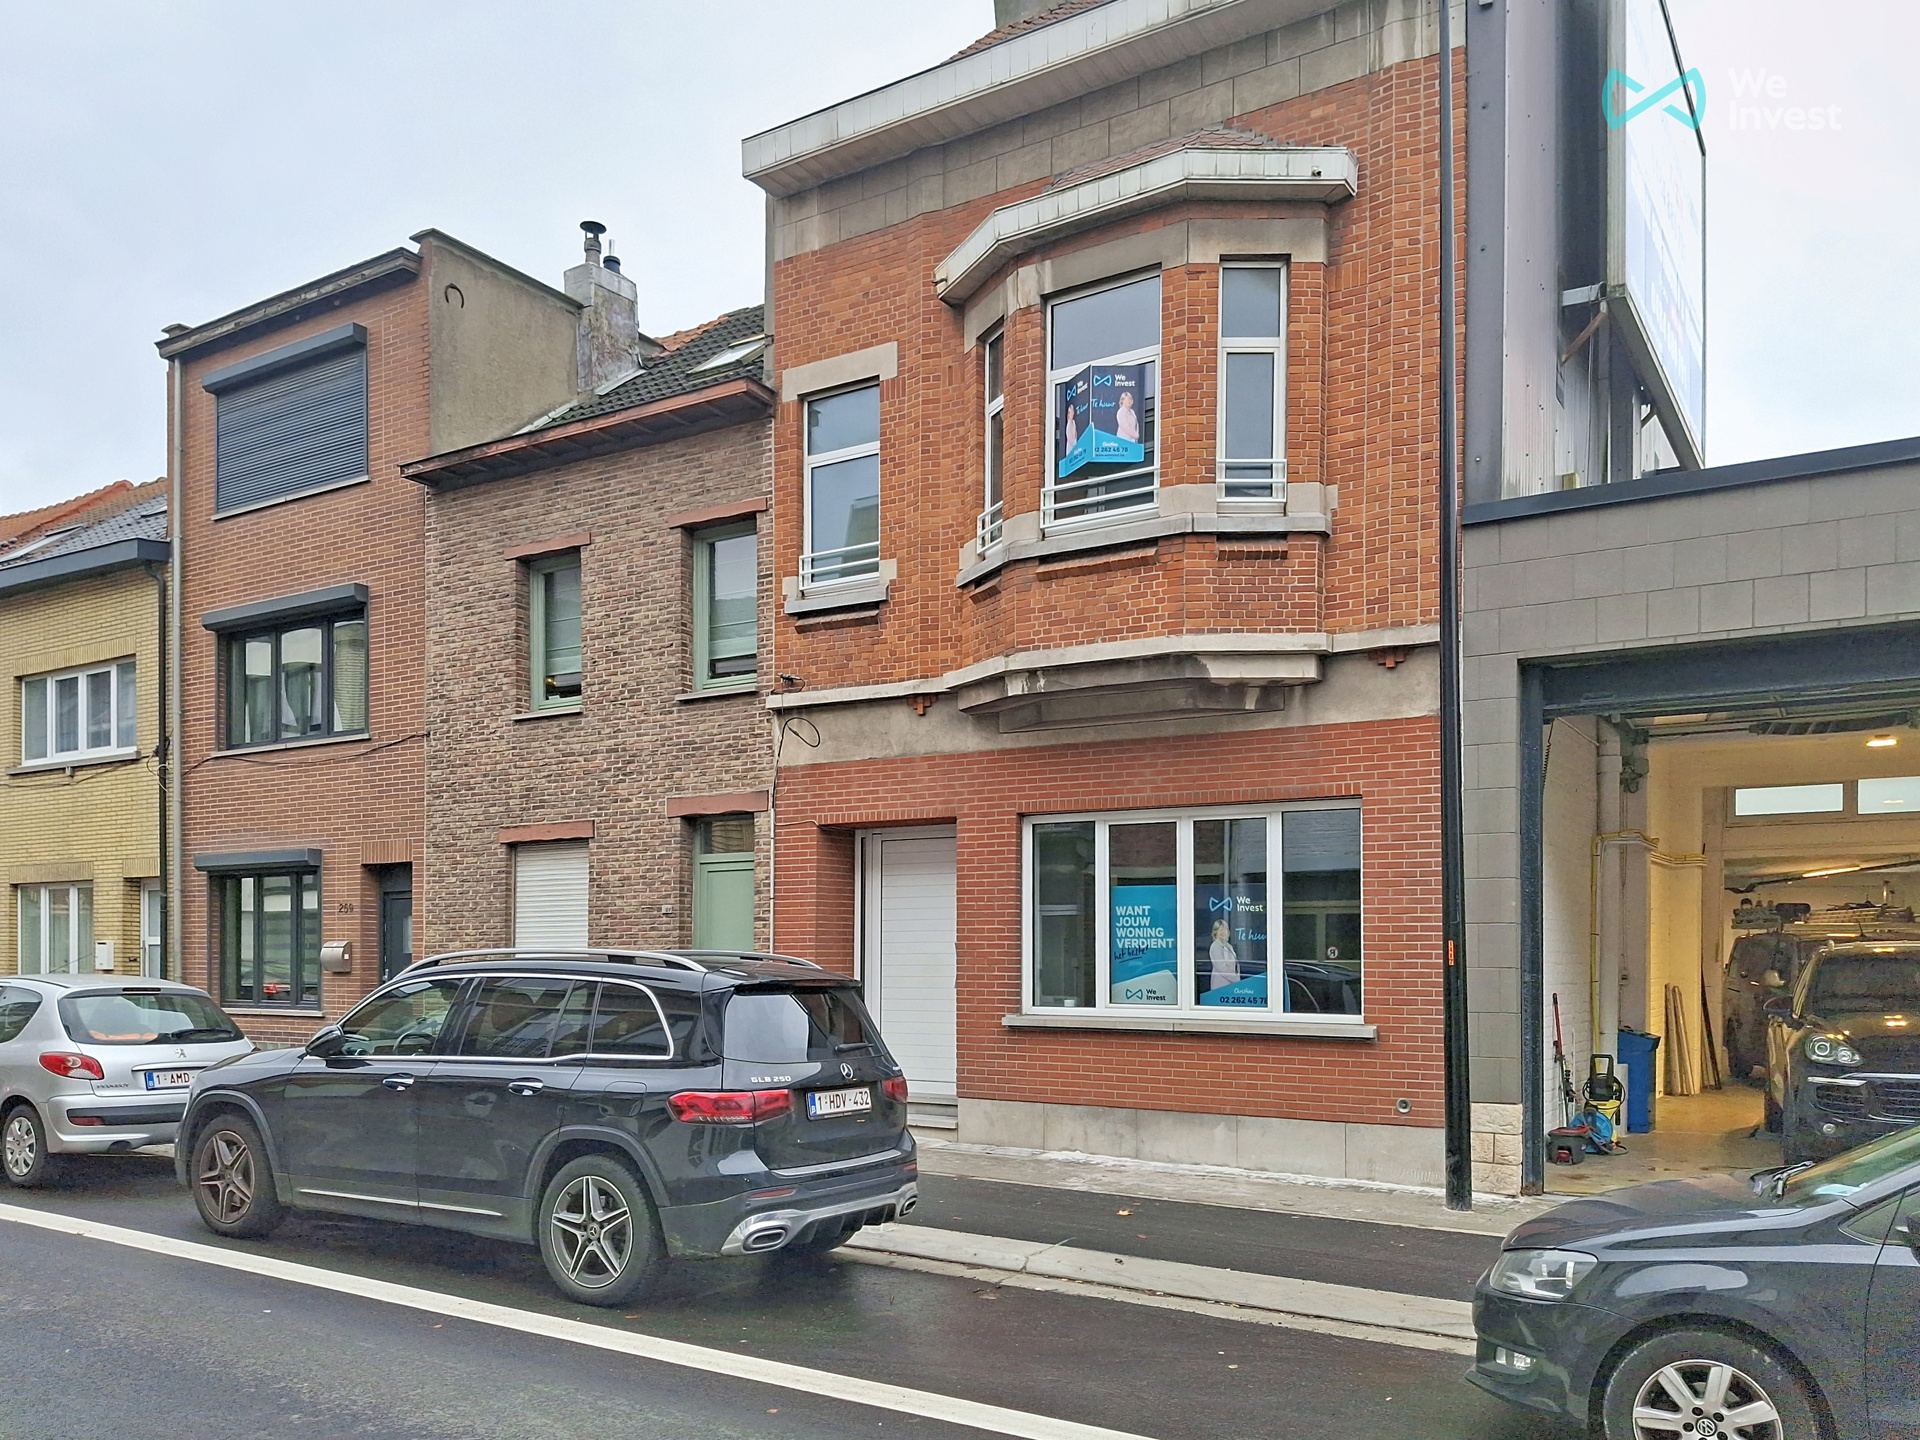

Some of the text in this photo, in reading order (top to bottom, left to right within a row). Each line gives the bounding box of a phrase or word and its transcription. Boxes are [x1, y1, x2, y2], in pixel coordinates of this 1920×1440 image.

[1236, 896, 1251, 905] We
[1115, 905, 1151, 916] WANT
[1237, 904, 1264, 912] Invest
[1115, 916, 1151, 927] JOUW
[1116, 927, 1165, 938] WONING
[1235, 927, 1246, 940] Te
[1116, 938, 1175, 949] VERDIENT
[1219, 996, 1230, 1004] 02
[1231, 996, 1246, 1004] 262
[1247, 996, 1258, 1005] 45
